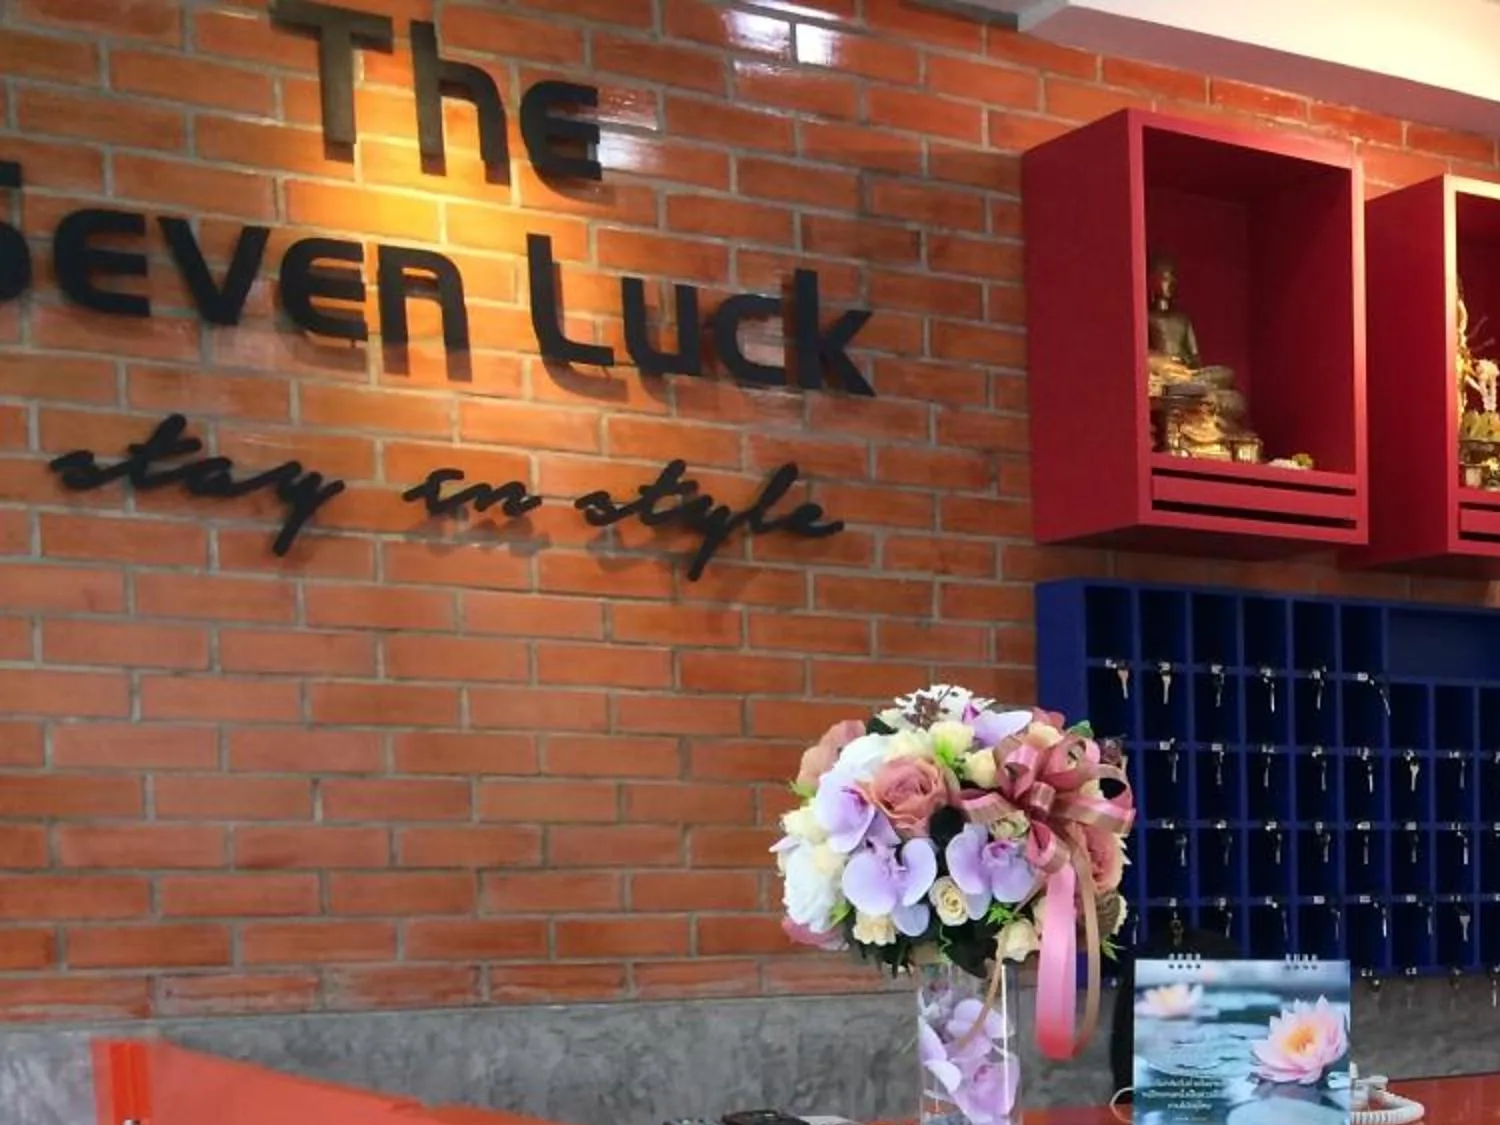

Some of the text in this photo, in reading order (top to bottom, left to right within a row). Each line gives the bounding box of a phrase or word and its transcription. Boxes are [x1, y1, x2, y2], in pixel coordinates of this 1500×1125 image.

[269, 0, 602, 187] The
[526, 232, 876, 397] Luck
[50, 413, 844, 581] stay in style
